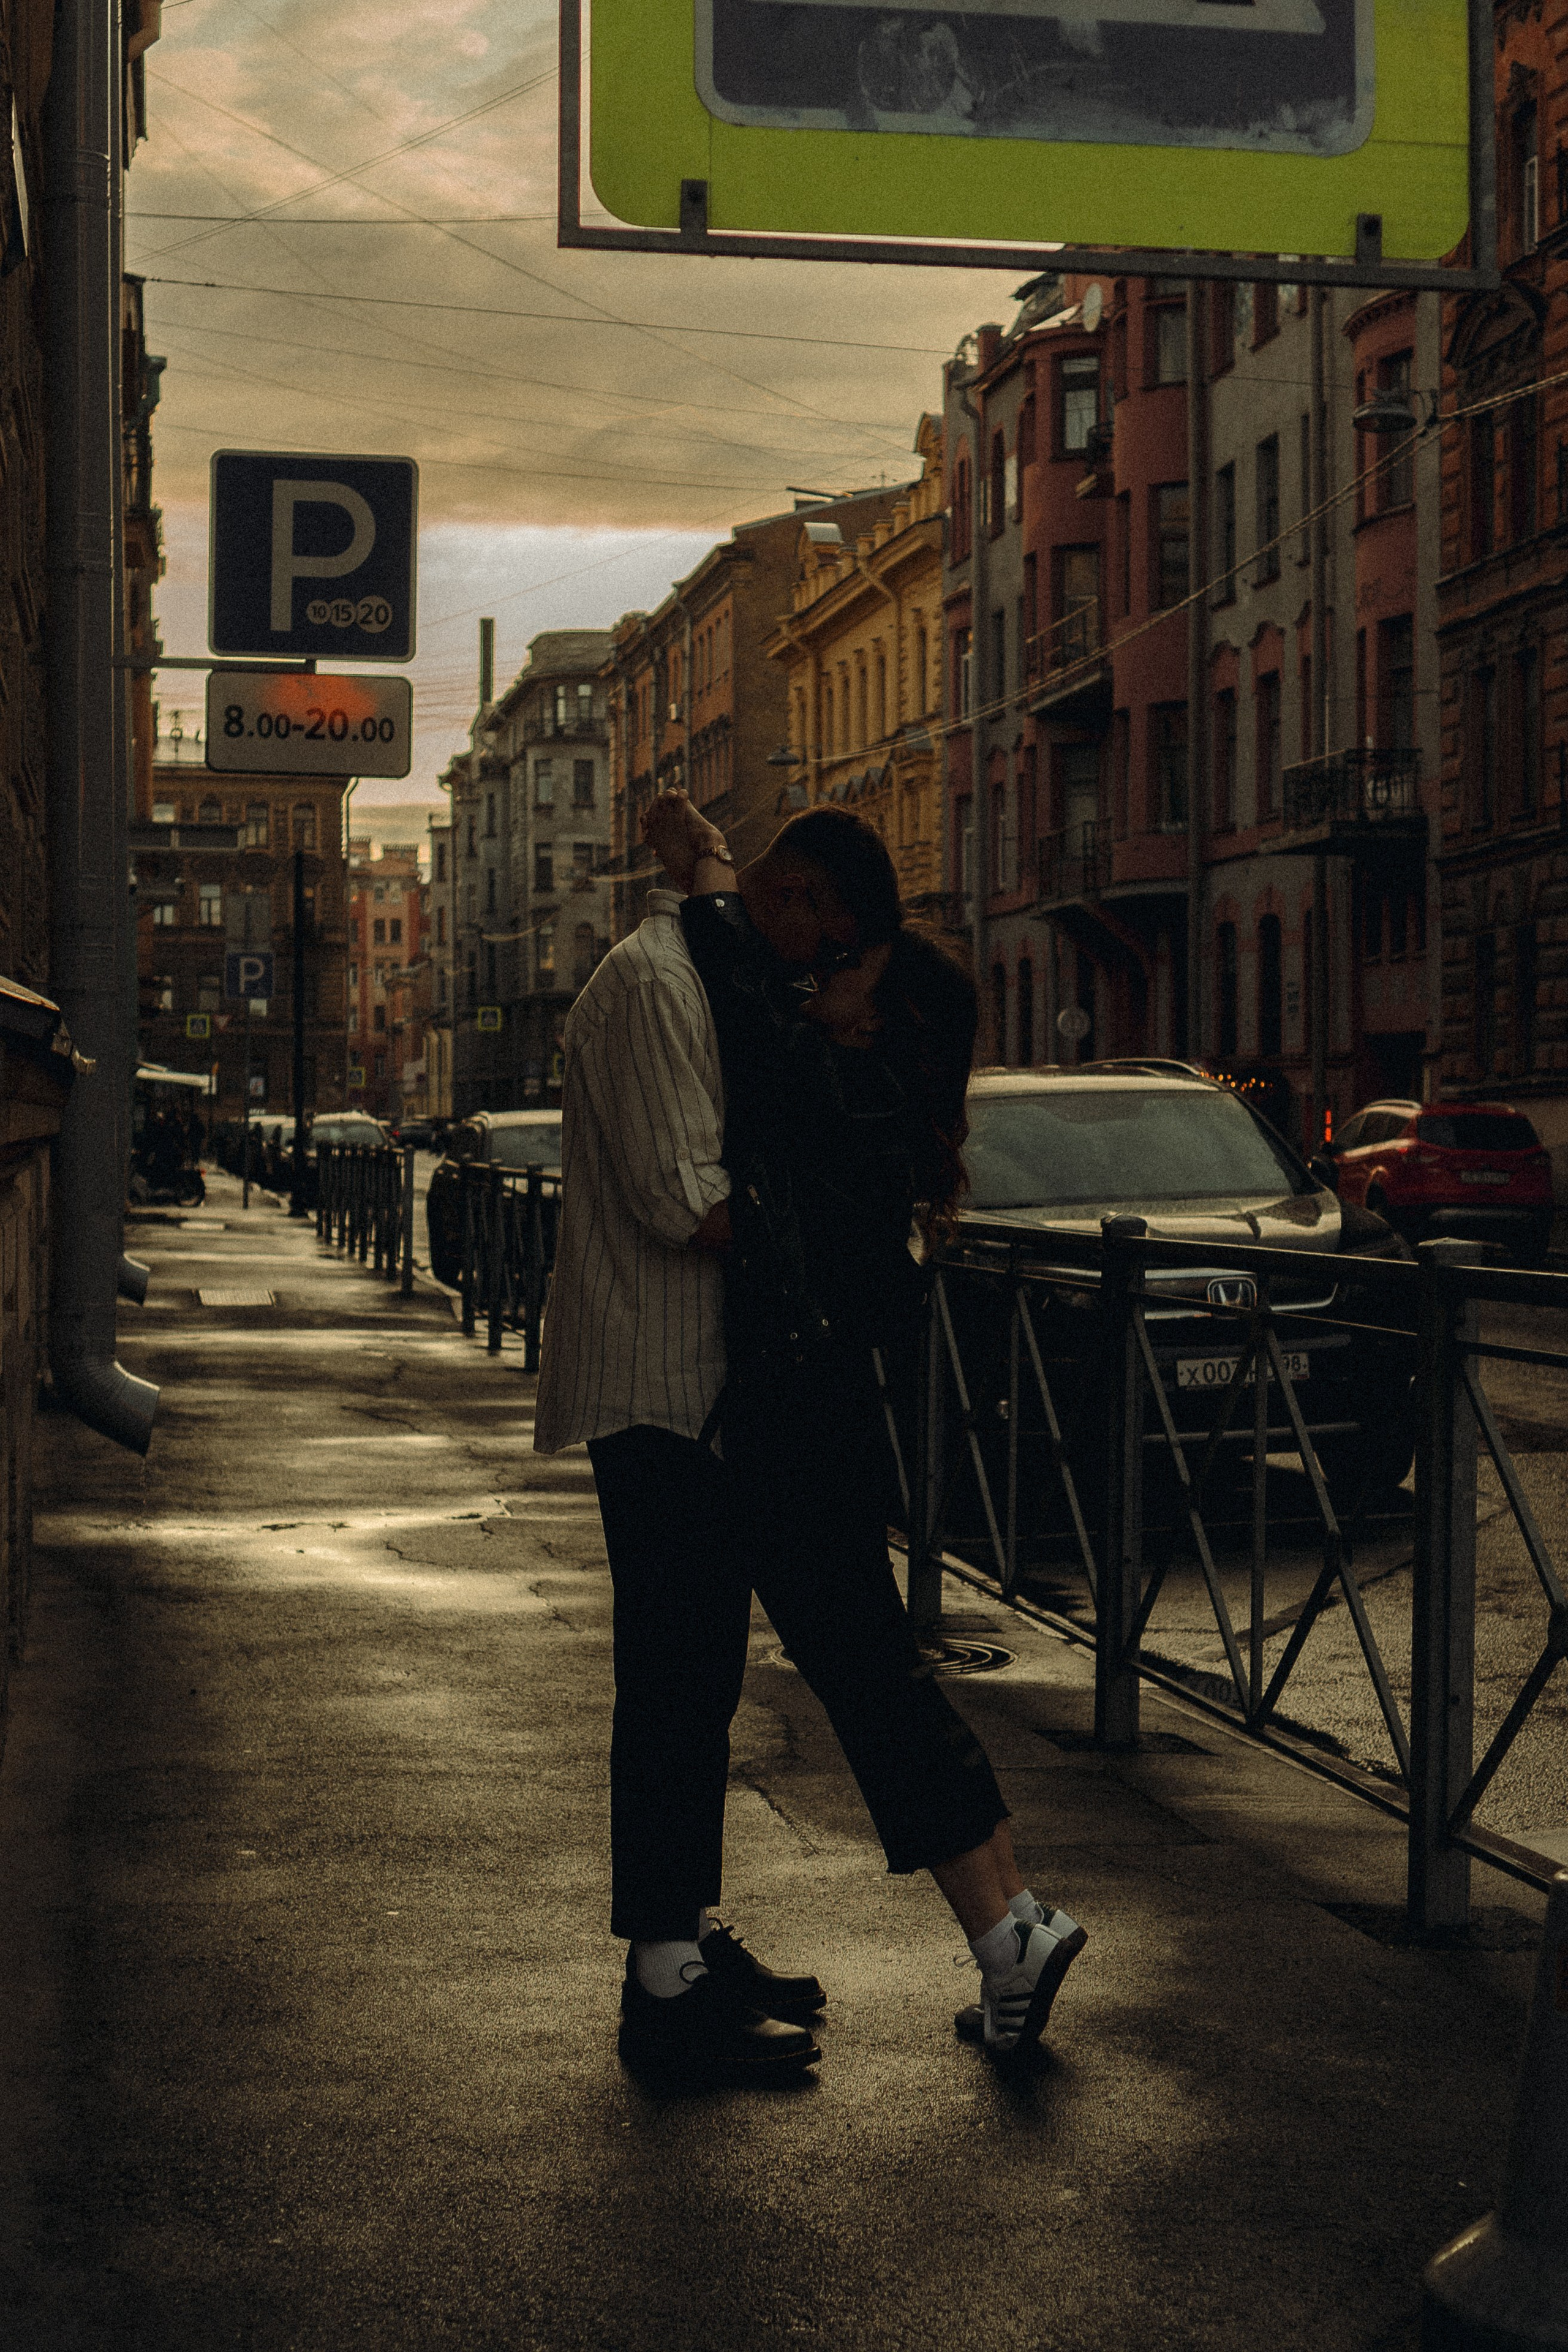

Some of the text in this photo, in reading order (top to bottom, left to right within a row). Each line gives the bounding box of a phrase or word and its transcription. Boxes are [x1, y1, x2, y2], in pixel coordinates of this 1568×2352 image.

[270, 479, 376, 631] P
[311, 603, 390, 624] 10 15 20
[224, 705, 395, 743] 8.00-20.00
[239, 957, 265, 995] P
